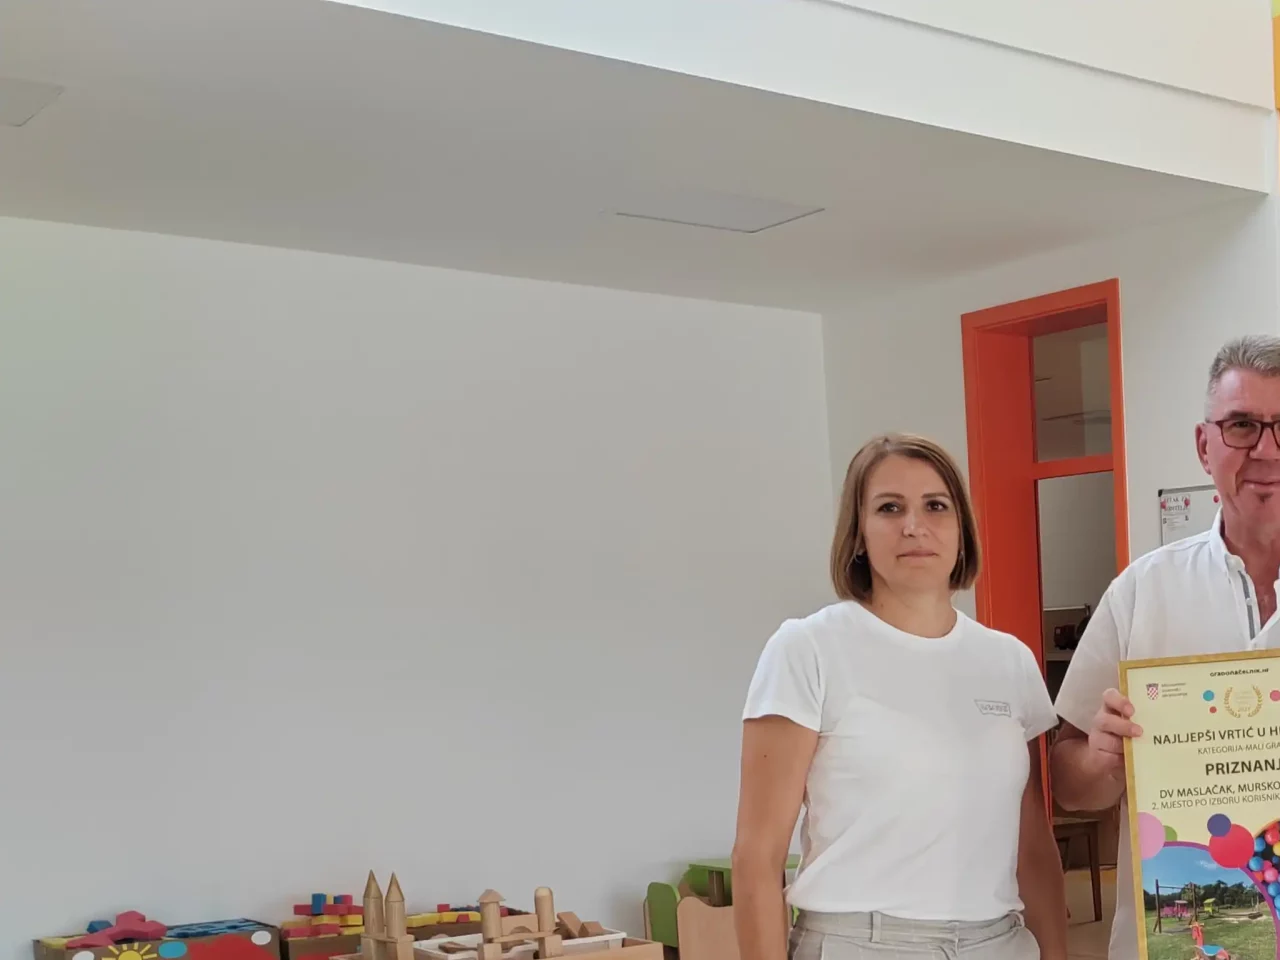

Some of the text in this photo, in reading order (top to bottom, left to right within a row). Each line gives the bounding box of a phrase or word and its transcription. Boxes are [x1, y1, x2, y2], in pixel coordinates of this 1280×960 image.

[1153, 729, 1216, 745] NAJLJEPŠI
[1218, 726, 1254, 740] VRTIĆ
[1257, 727, 1266, 737] U
[1159, 789, 1174, 799] DV
[1177, 784, 1235, 797] MASLAČAK,
[1238, 781, 1280, 793] MURSKO
[1152, 802, 1160, 810] 2.
[1160, 799, 1193, 809] MJESTO
[1195, 798, 1208, 807] PO
[1209, 796, 1240, 806] IZBORU
